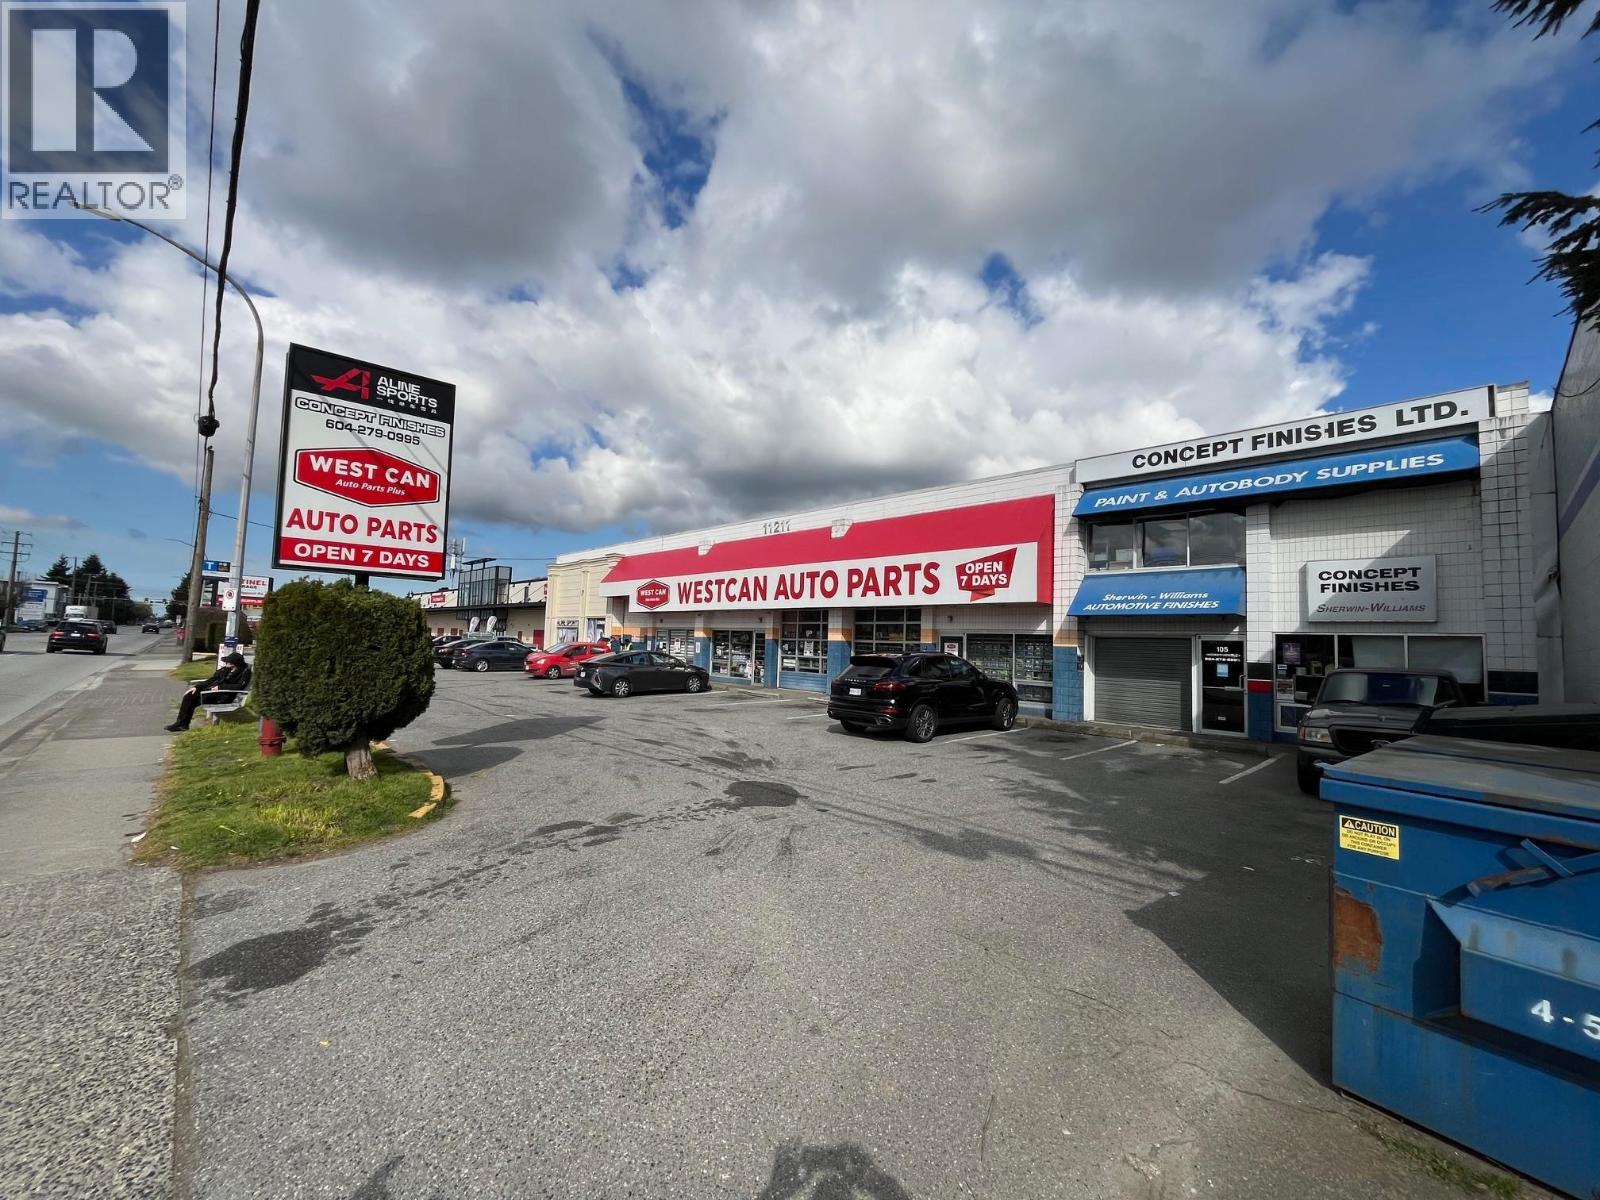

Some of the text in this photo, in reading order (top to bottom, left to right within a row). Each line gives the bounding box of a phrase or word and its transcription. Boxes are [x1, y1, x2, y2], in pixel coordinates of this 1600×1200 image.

[377, 376, 421, 395] ALINE
[376, 385, 438, 408] SPORTS
[295, 397, 377, 423] CONCEPT
[379, 410, 446, 438] FINISHES
[325, 418, 420, 446] 604-279-0995
[1132, 400, 1469, 469] CONCEPT FINISHES LTD.
[309, 454, 430, 489] WEST CAN
[1094, 453, 1445, 508] PAINT & AUTOBODY SUPPLIES
[335, 478, 406, 496] Auto Parts Plus
[286, 508, 438, 544] AUTO PARTS
[294, 543, 430, 568] OPEN 7 DAYS
[965, 560, 1003, 574] OPEN
[1318, 567, 1422, 581] CONCEPT
[677, 561, 941, 605] WESTCAN AUTO PARTS
[960, 573, 1008, 587] 7 DAYS
[1320, 580, 1420, 594] FINISHES
[640, 588, 667, 597] WEST CAN
[1102, 593, 1148, 602] Sherwin
[1159, 591, 1208, 600] Williams
[1083, 600, 1219, 611] AUTOMOTIVE FINISHES
[1354, 820, 1396, 837] CAUTION
